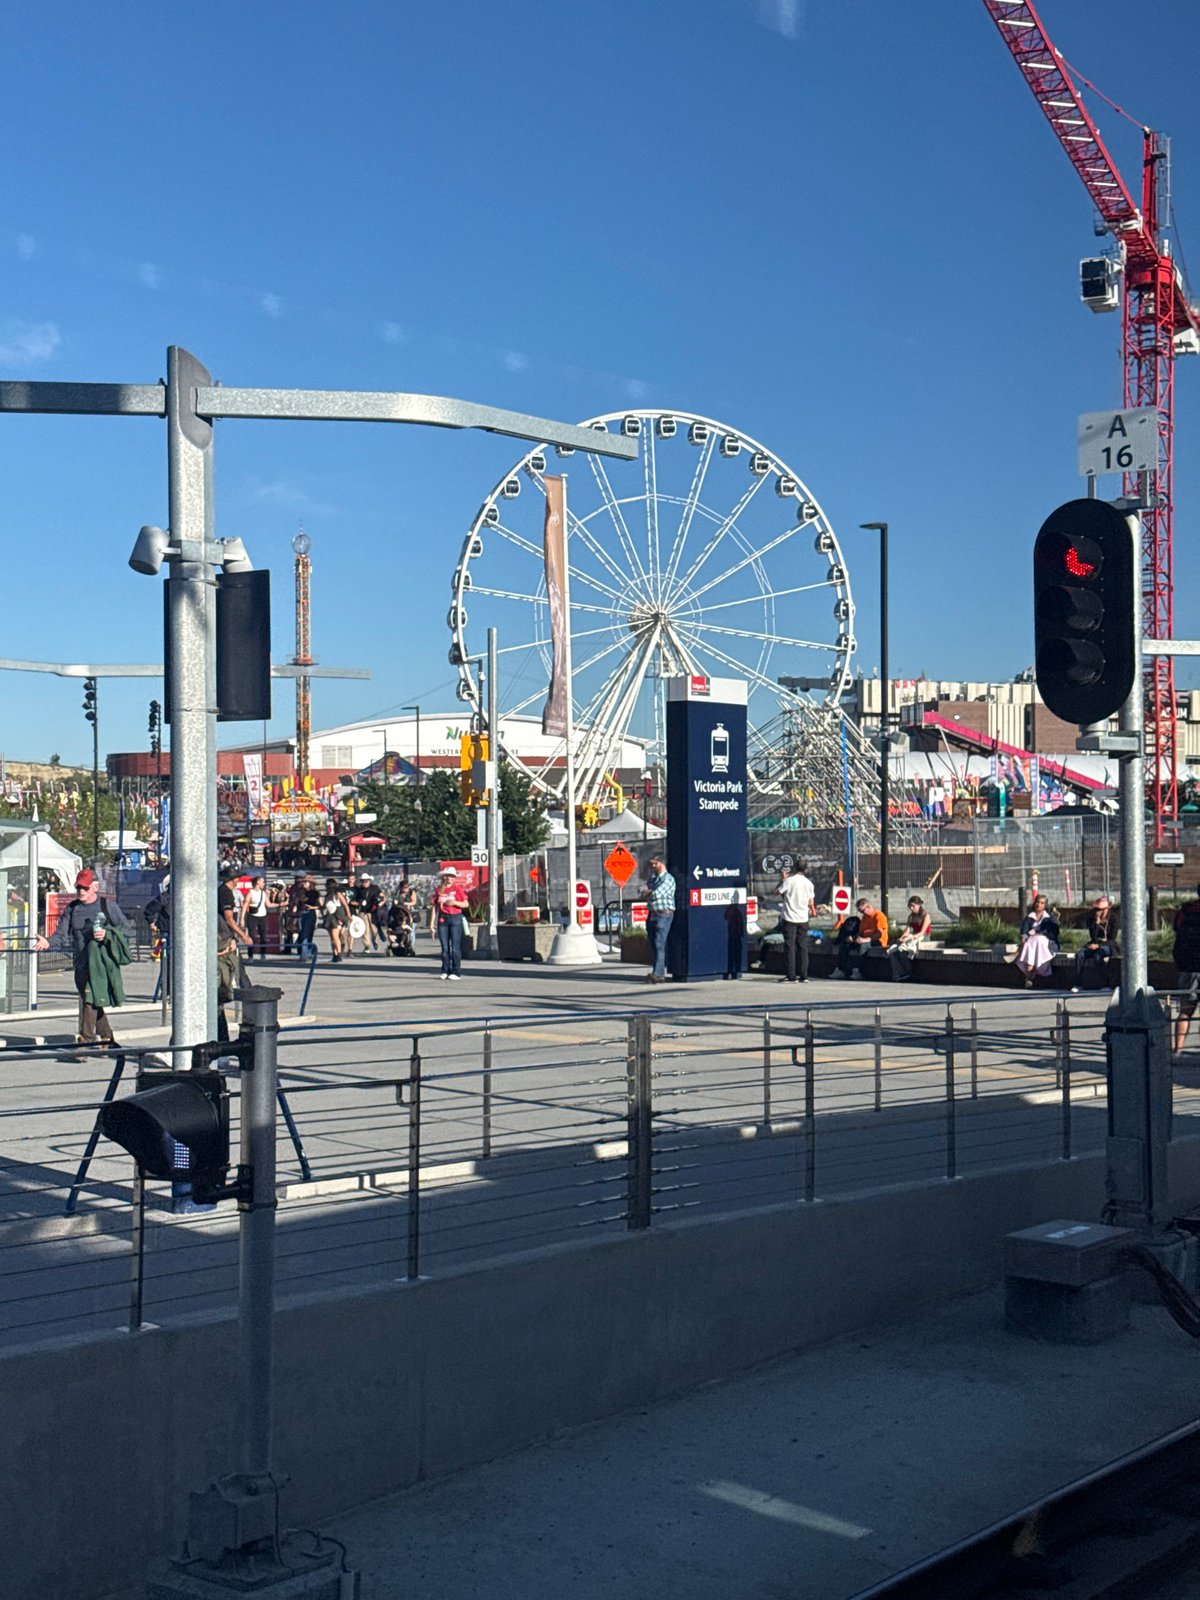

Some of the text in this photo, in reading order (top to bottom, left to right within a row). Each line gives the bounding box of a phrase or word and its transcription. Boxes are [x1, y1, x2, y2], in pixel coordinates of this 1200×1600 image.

[1107, 414, 1128, 439] A
[1101, 444, 1133, 470] 16
[250, 780, 258, 791] 2
[694, 780, 743, 794] Victoria Park
[699, 797, 739, 813] Stampede
[473, 853, 488, 863] 30
[705, 867, 740, 878] To Northwest
[692, 891, 730, 904] R RED LINE
